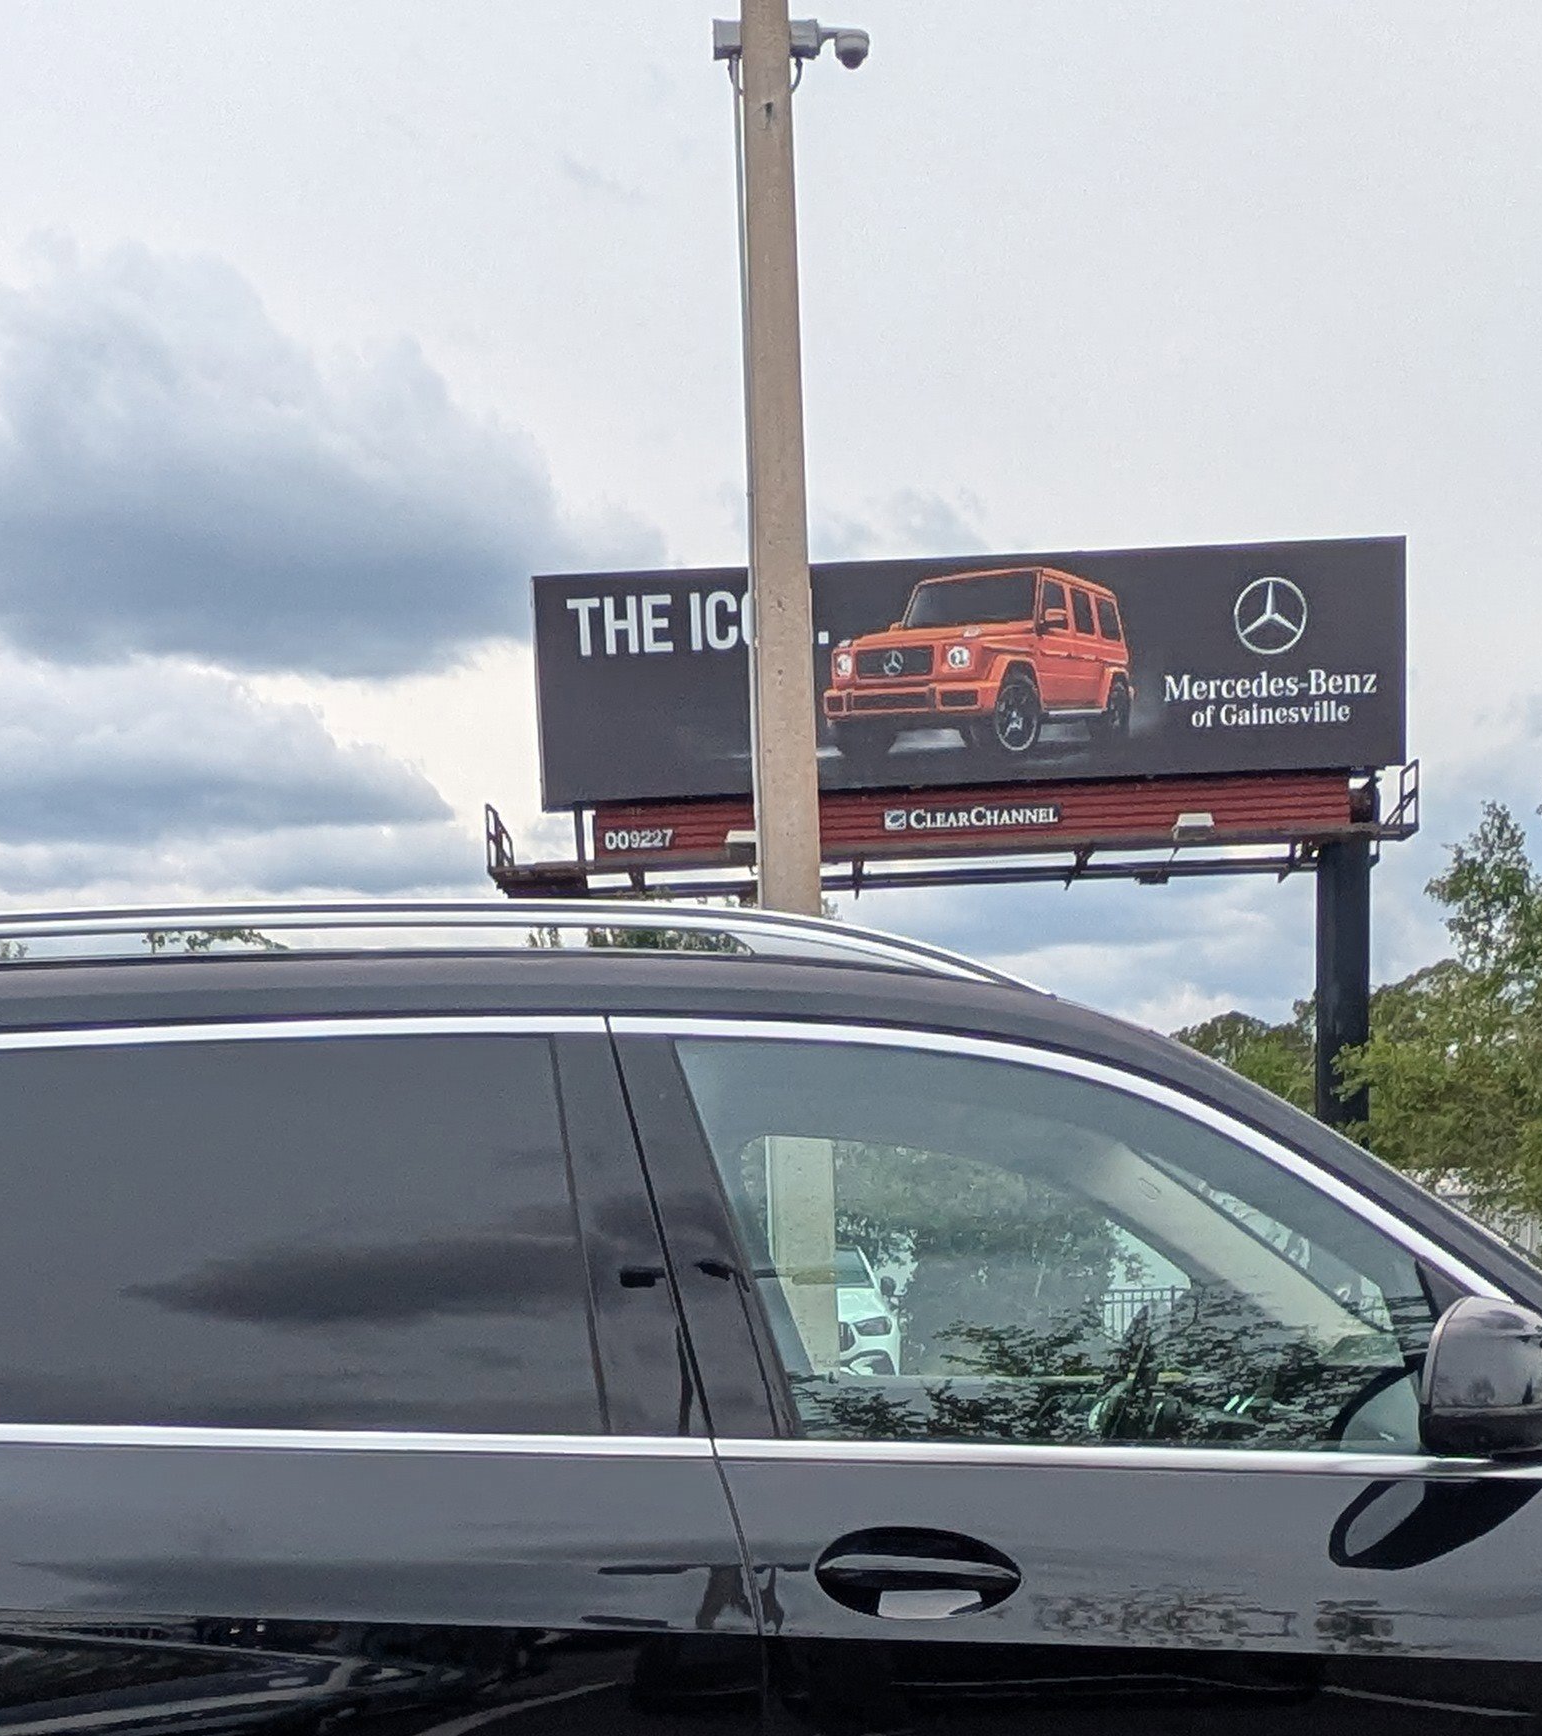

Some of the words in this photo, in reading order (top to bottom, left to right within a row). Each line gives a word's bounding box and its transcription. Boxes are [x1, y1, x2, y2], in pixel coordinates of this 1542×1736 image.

[566, 594, 674, 656] THE
[1163, 669, 1378, 702] Mercedes-Benz
[1191, 704, 1216, 728] of
[1219, 700, 1351, 727] Gainesville
[604, 828, 674, 850] 009227
